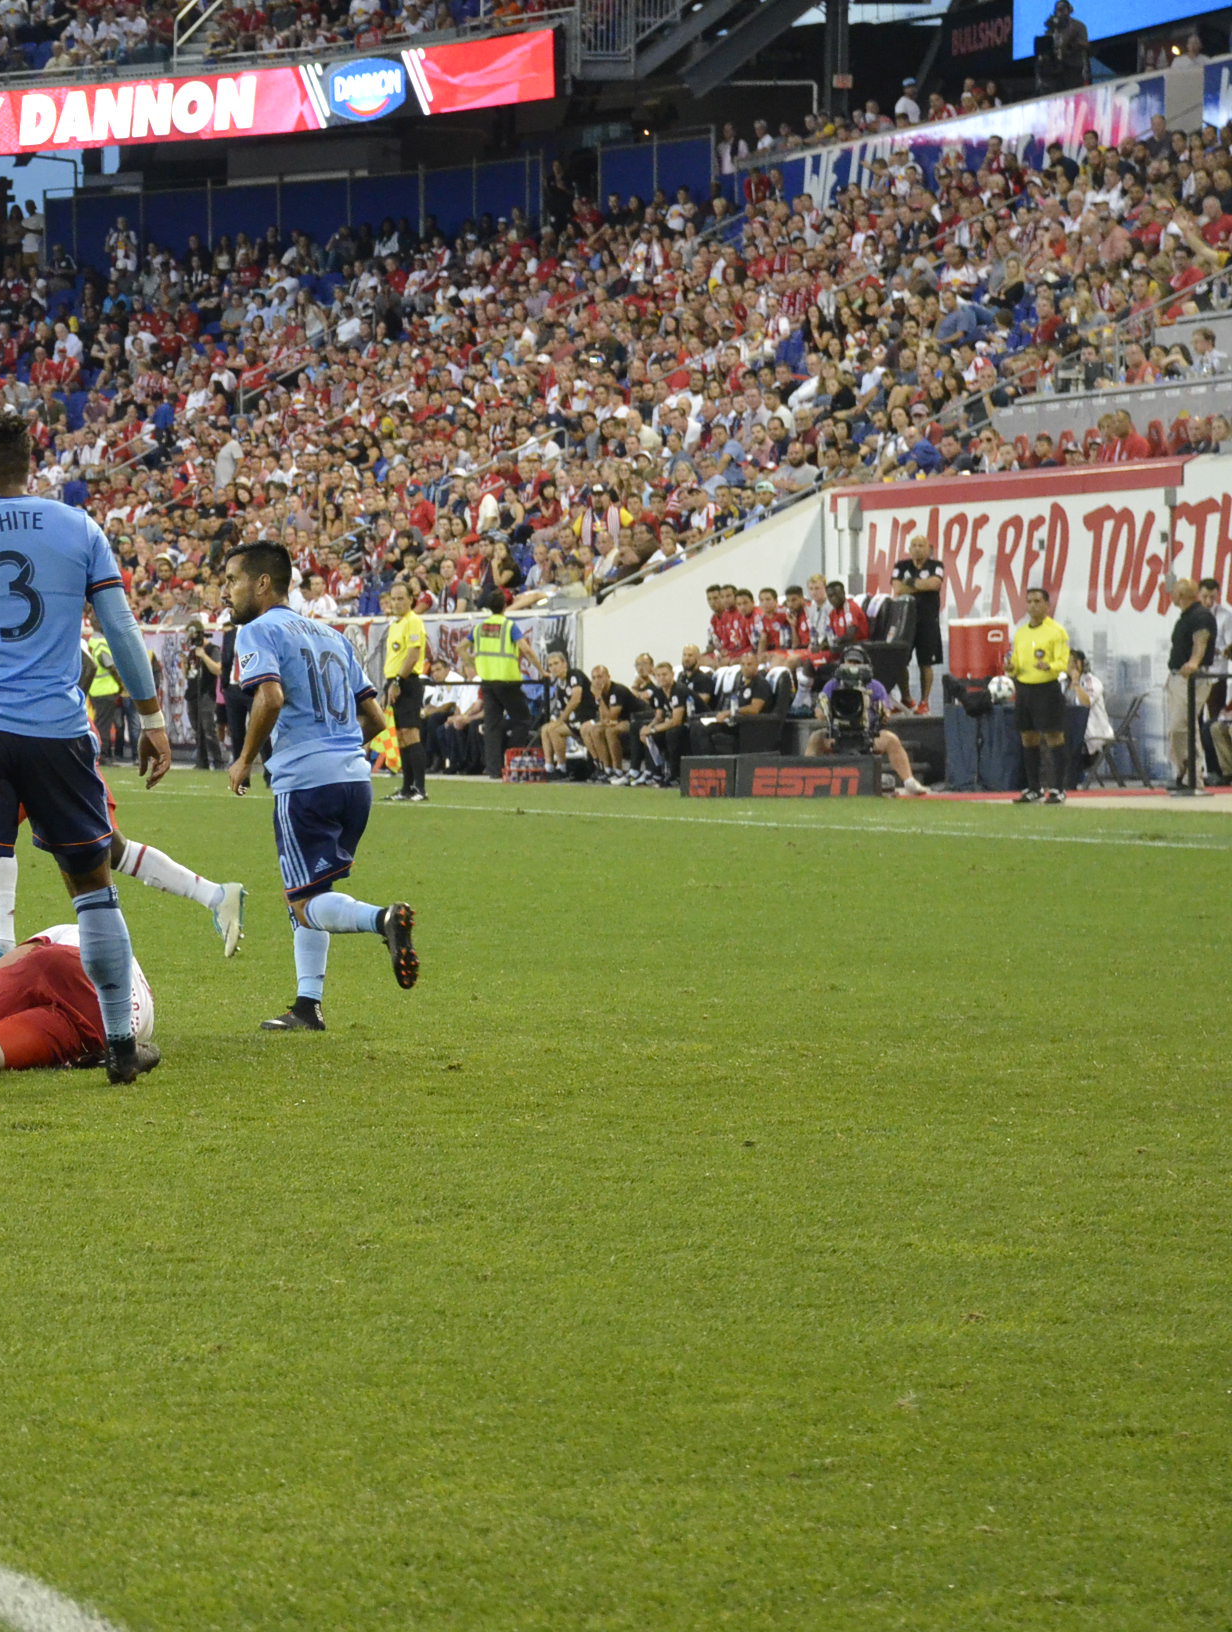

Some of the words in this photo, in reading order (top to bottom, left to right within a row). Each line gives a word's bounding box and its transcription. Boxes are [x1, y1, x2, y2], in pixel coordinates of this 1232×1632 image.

[18, 75, 257, 147] DANNON
[334, 69, 401, 102] DANNON
[990, 501, 1070, 624] RED
[299, 647, 350, 726] 10
[689, 768, 727, 797] ESPN
[752, 766, 860, 797] ESPN
